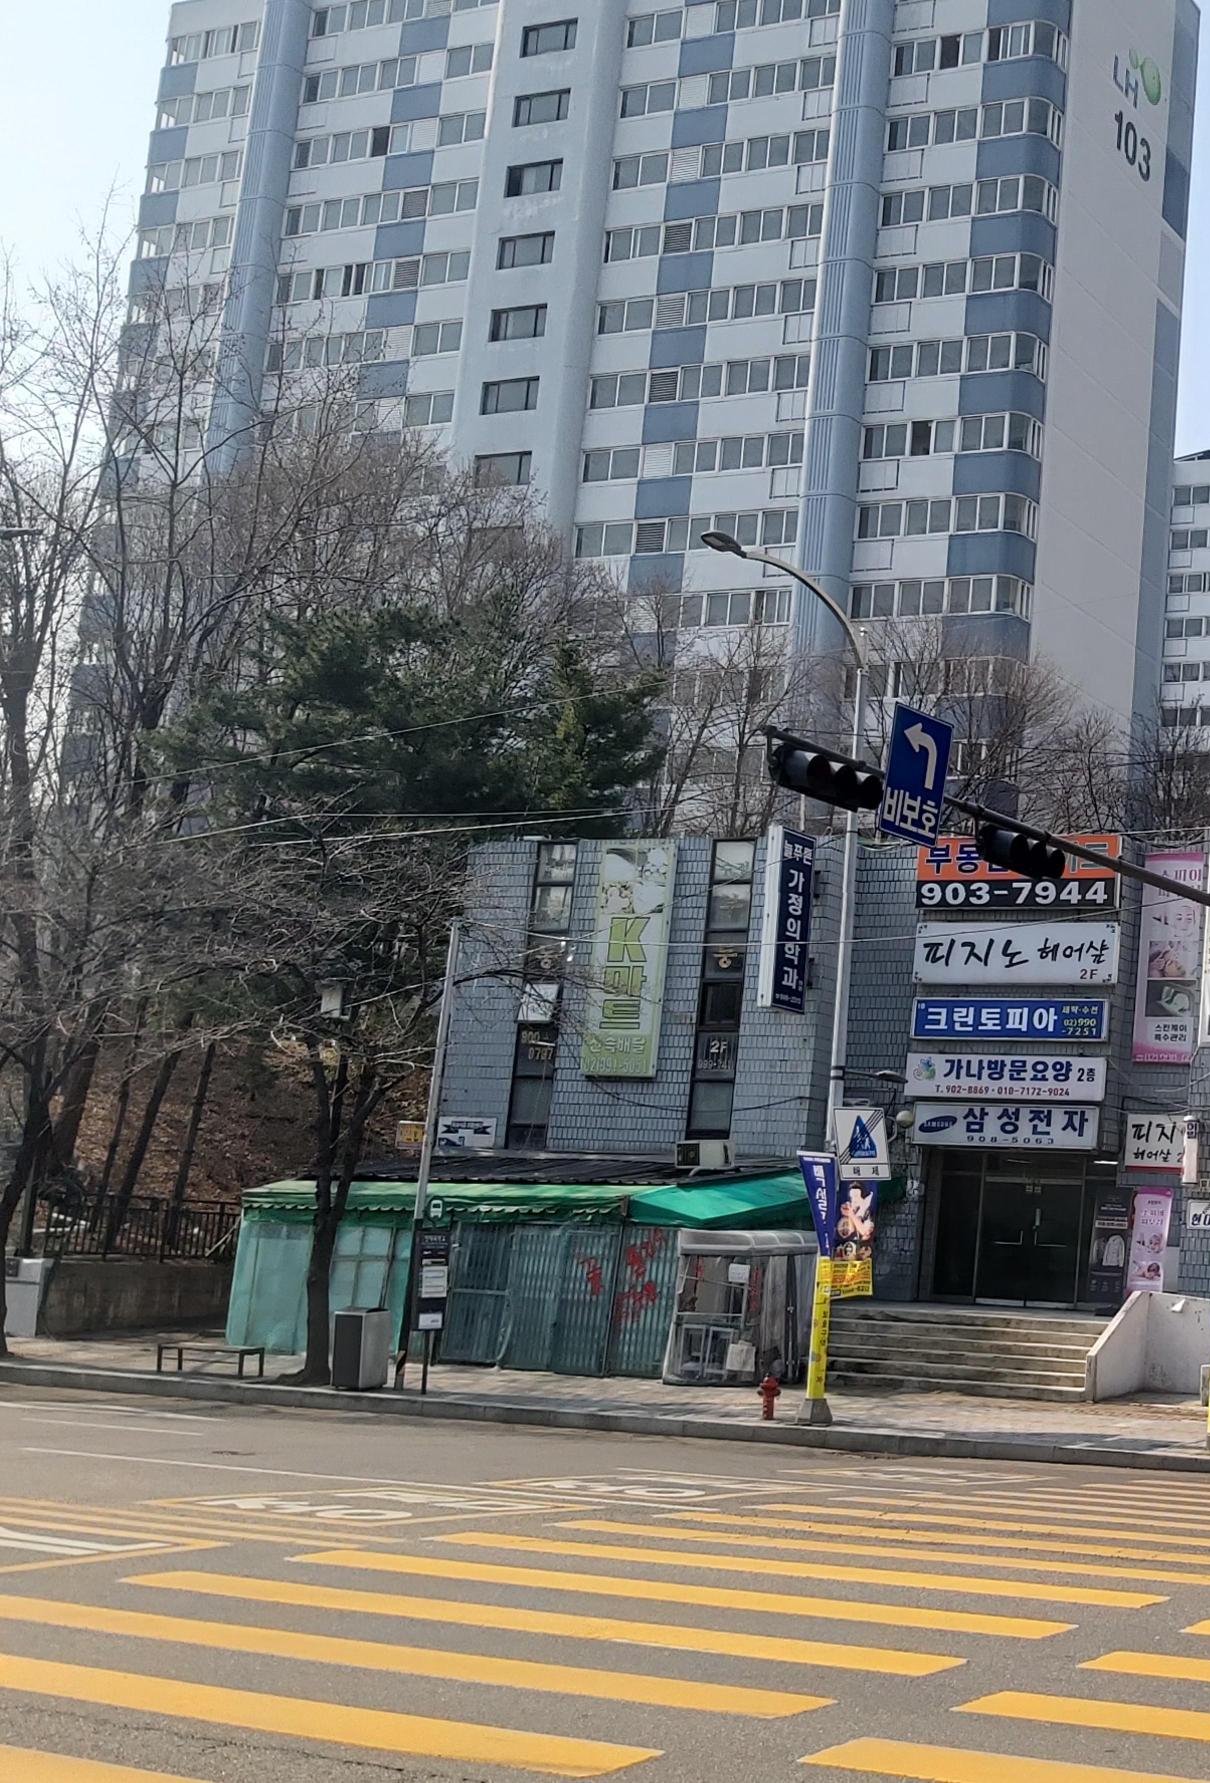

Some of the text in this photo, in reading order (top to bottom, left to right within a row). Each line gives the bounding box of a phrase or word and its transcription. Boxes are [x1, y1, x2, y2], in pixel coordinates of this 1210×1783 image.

[1113, 55, 1139, 109] LH
[1115, 110, 1151, 182] 103
[883, 787, 938, 838] 비보호
[920, 881, 1108, 906] 903-7944
[782, 869, 805, 990] 가정의학과
[923, 937, 1030, 968] 피지노
[599, 916, 651, 1030] K마트
[1079, 968, 1098, 980] 2F
[924, 1006, 1058, 1032] 크린토피아
[710, 1040, 728, 1052] 2F
[943, 1058, 1096, 1082] 가나방문요양 2층
[963, 1107, 1089, 1137] 삼성전자
